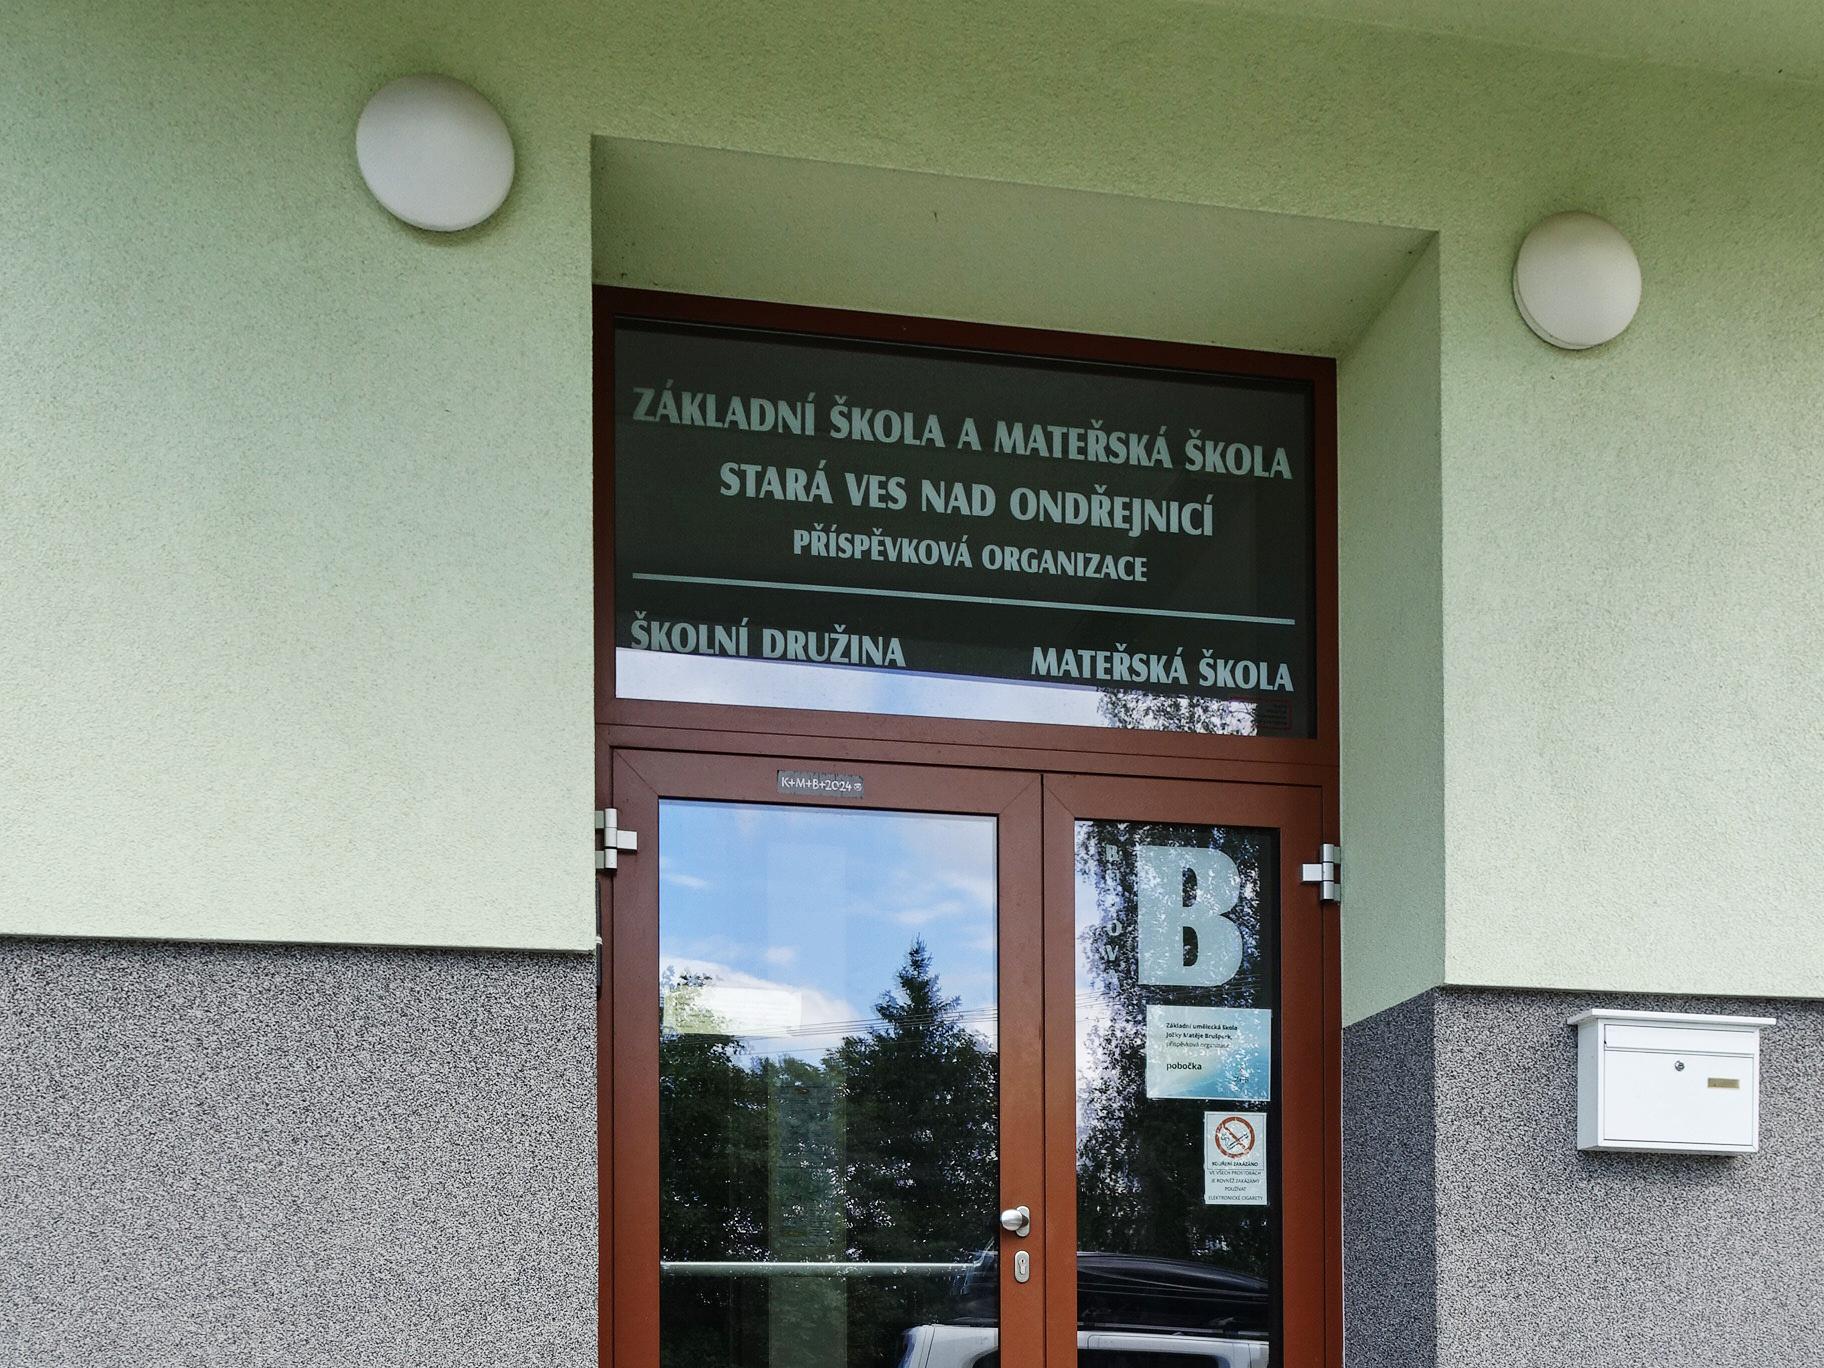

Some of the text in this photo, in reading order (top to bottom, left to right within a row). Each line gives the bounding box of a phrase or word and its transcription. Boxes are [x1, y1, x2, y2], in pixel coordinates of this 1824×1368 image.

[633, 379, 1293, 479] ZÁKLADNÍ ŠKOLA A MATEŘSKÁ ŠKOLA
[720, 460, 1213, 538] STARÁ VES NAD ONDŘEJNICÍ
[793, 522, 1147, 582] PŘÍSPĚVKOVÁ ORGANIZACE
[631, 610, 906, 667] ŠKOLNÍ DRUŽINA
[1031, 643, 1294, 692] MATEŘSKÁ ŠKOLA
[1137, 845, 1243, 987] B
[1166, 1061, 1202, 1071] pobočka
